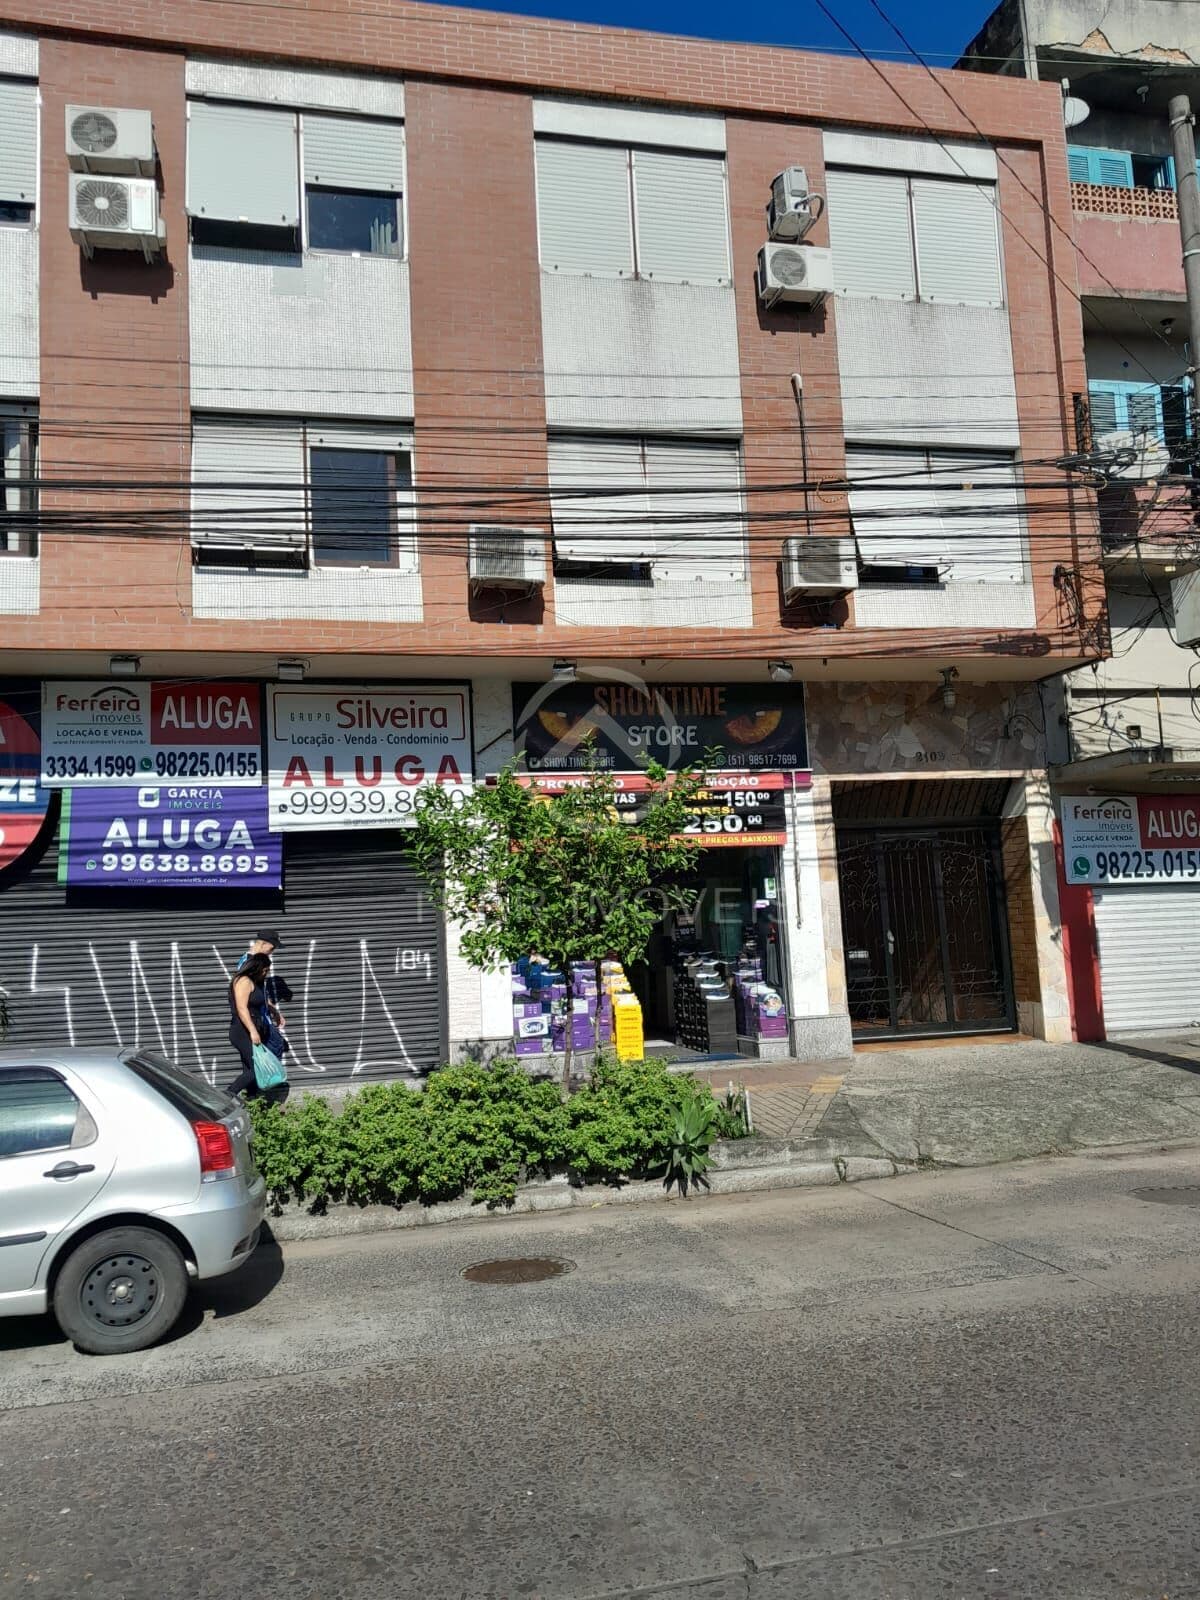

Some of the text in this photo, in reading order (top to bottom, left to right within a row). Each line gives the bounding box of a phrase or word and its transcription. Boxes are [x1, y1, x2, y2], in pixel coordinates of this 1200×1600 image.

[57, 694, 140, 711] Ferreira
[594, 686, 727, 716] SHOWTIME
[92, 712, 141, 723] imóveis
[160, 695, 253, 729] ALUGA
[290, 712, 331, 722] GRUPO
[336, 699, 448, 729] Silveira
[57, 727, 143, 737] LOCAÇÃO E VENDA
[291, 733, 334, 747] Locação
[344, 733, 377, 745] Venda
[627, 725, 698, 746] STORE
[46, 752, 258, 778] 3334.1599 98225.0155
[728, 753, 798, 766] (51) 98517-7699
[282, 754, 463, 787] ALUGA
[168, 789, 223, 800] GARCIA
[168, 800, 222, 810] IMÓVEIS
[1073, 805, 1132, 820] Ferreira
[102, 817, 255, 849] ALUGA
[102, 853, 269, 873] 99638.8695
[1096, 850, 1200, 879] 98225.015
